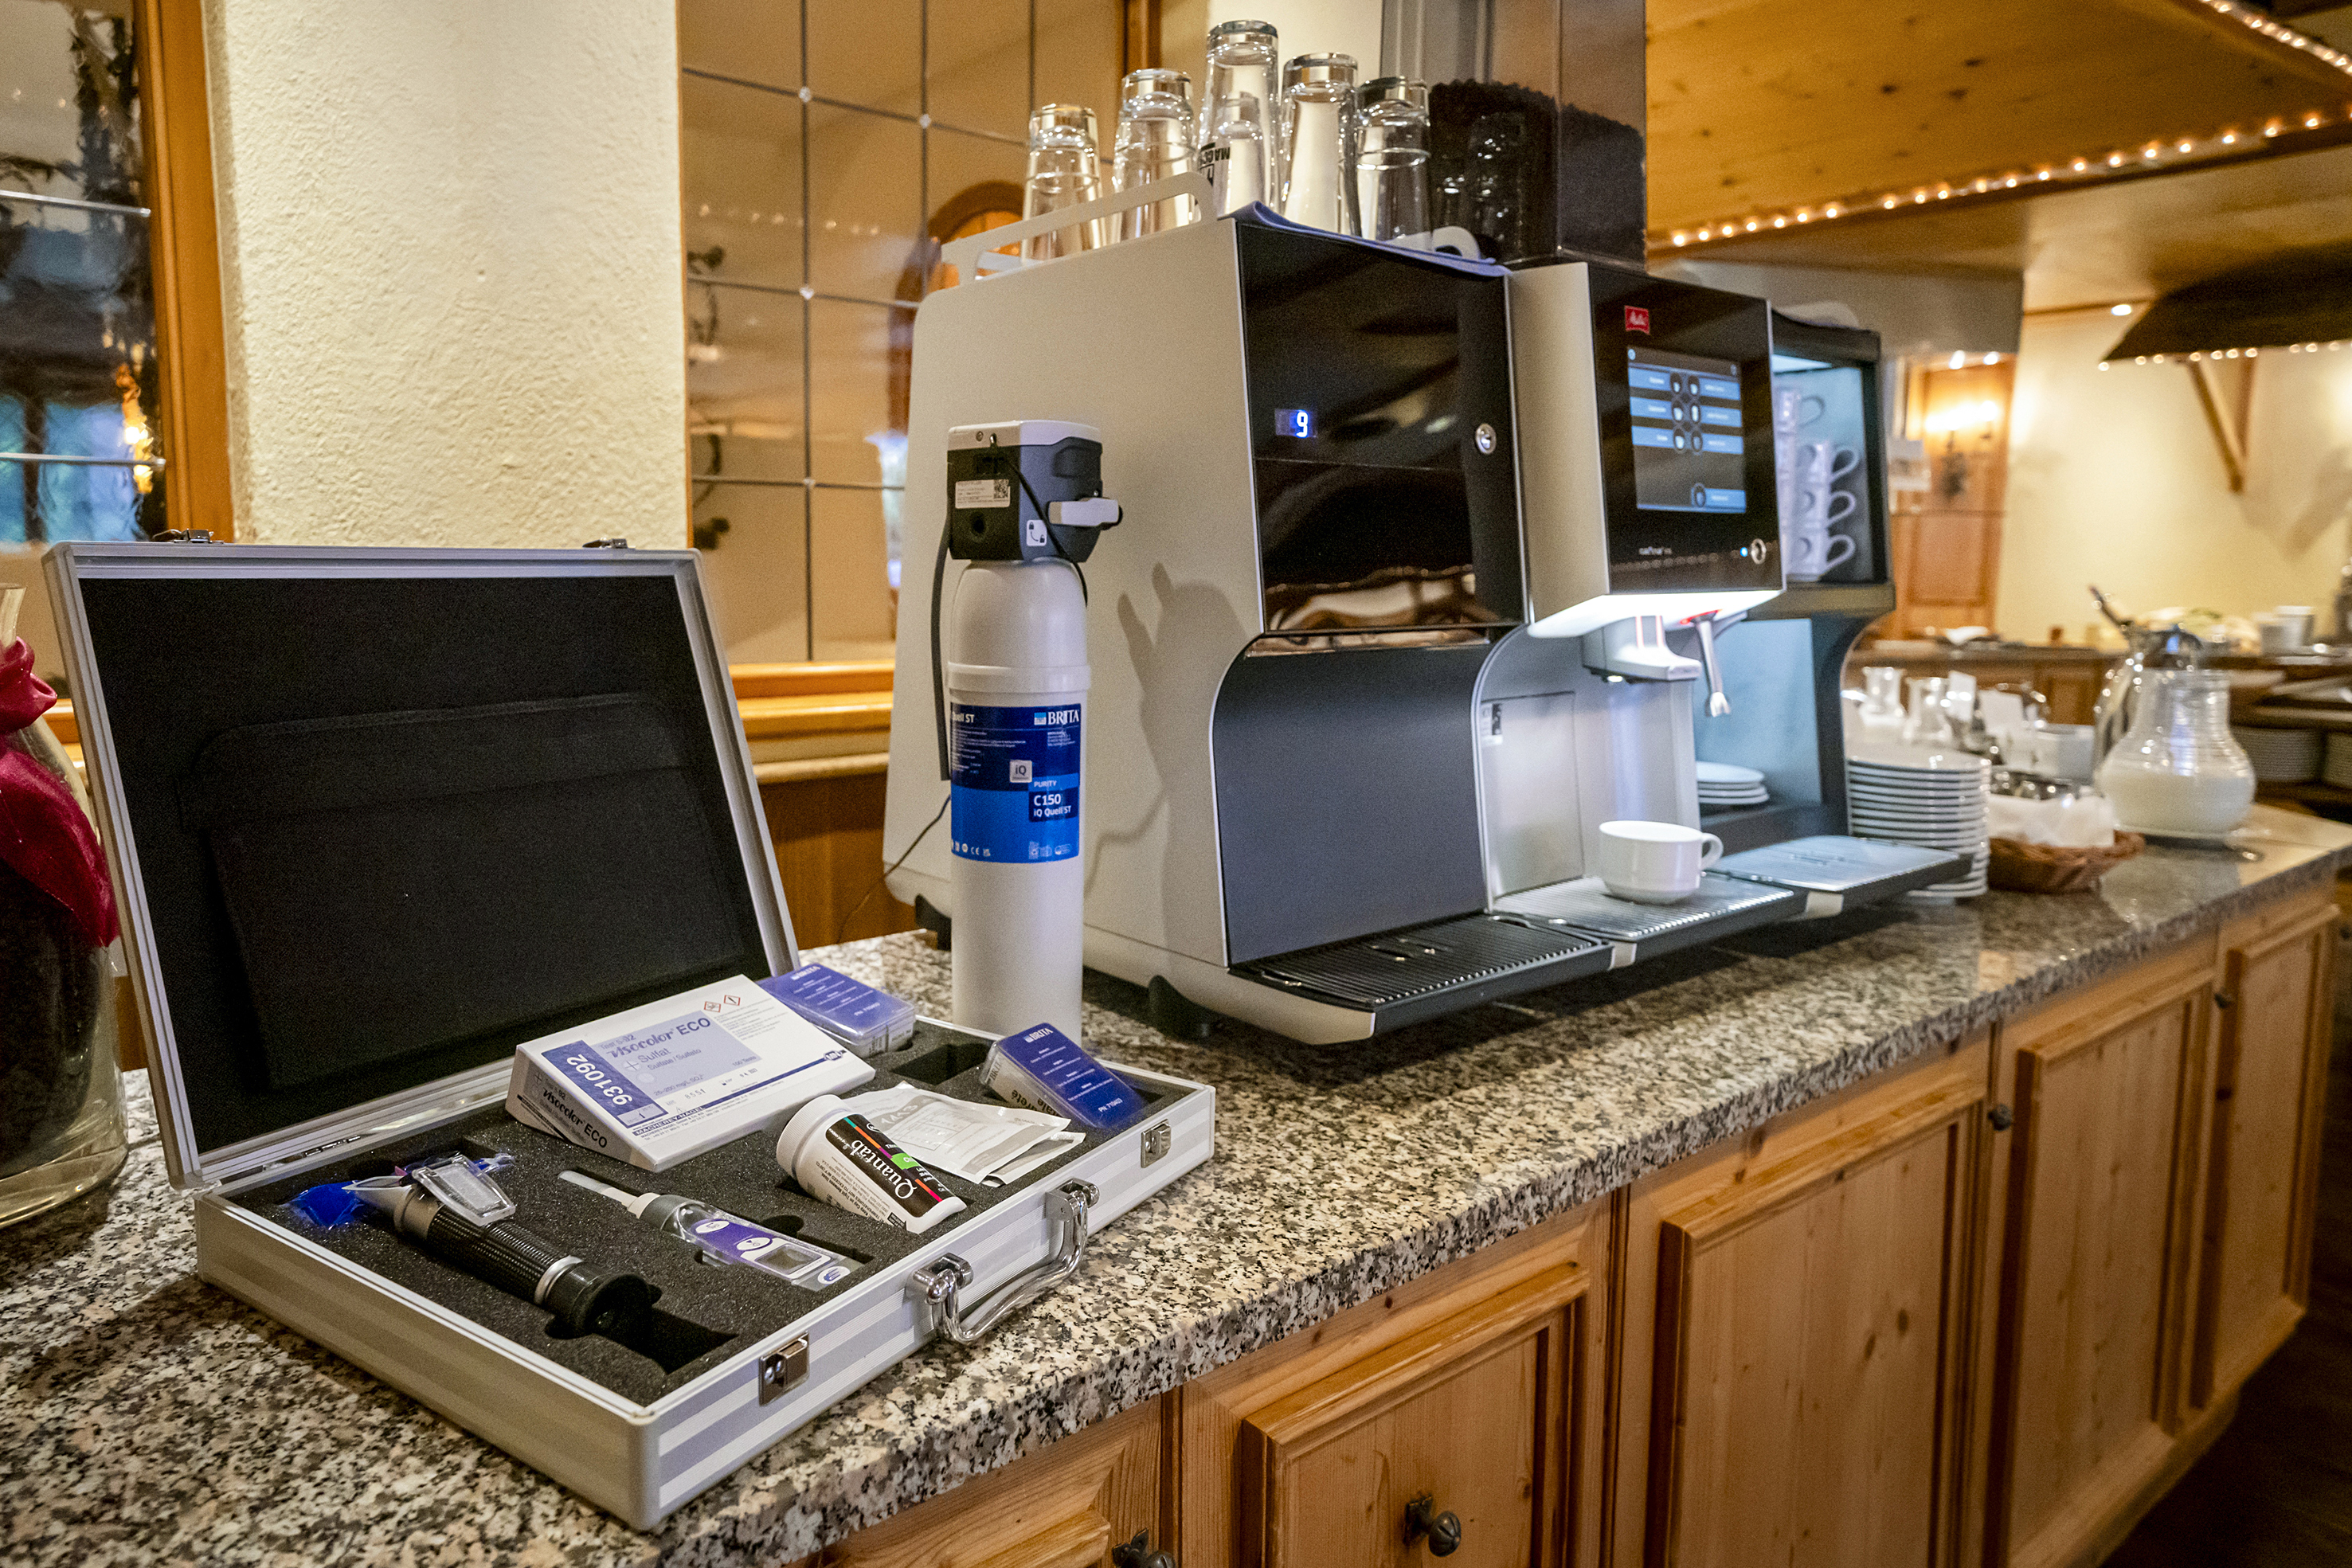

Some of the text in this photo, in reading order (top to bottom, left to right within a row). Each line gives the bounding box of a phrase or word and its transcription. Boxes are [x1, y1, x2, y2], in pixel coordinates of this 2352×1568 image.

[1297, 410, 1309, 438] 9
[965, 714, 975, 723] ST
[1047, 710, 1079, 725] BRITA
[1016, 764, 1027, 776] iQ
[1034, 794, 1062, 806] C150
[1044, 806, 1063, 817] Quell
[1064, 805, 1071, 814] ST
[676, 1017, 711, 1036] ECO
[1030, 1027, 1054, 1042] BRITA
[637, 1047, 671, 1064] Sulfat
[648, 1057, 674, 1071] Sulfate
[676, 1049, 702, 1061] Sulfato
[566, 1053, 633, 1106] 931092
[584, 1123, 608, 1148] ECO
[850, 1140, 918, 1199] Quantab
[855, 1195, 880, 1220] TEMPERATURES
